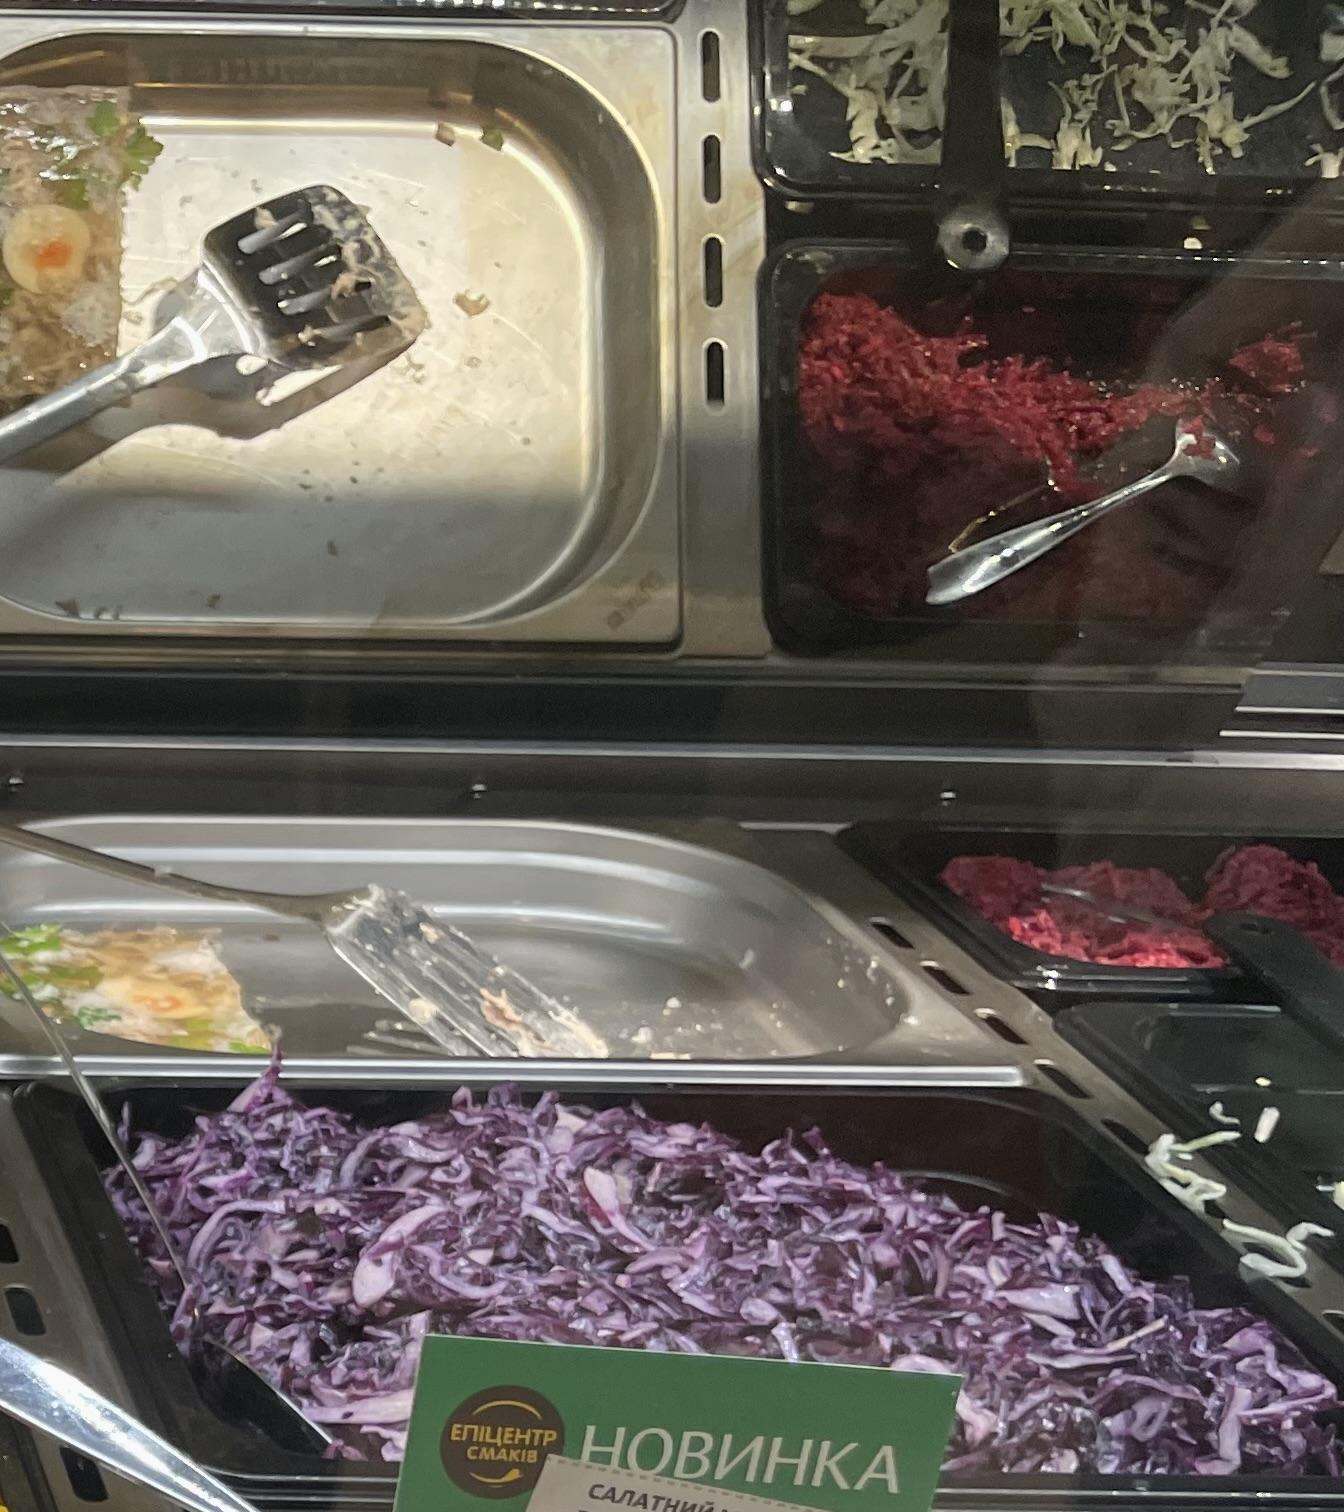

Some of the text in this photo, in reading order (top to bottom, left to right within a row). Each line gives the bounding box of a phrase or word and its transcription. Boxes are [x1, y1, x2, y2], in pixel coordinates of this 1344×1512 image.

[450, 1423, 558, 1447] ЕПІЦЕНТР
[466, 1445, 539, 1464] СМАКІВ
[579, 1424, 900, 1495] НОВИНКА
